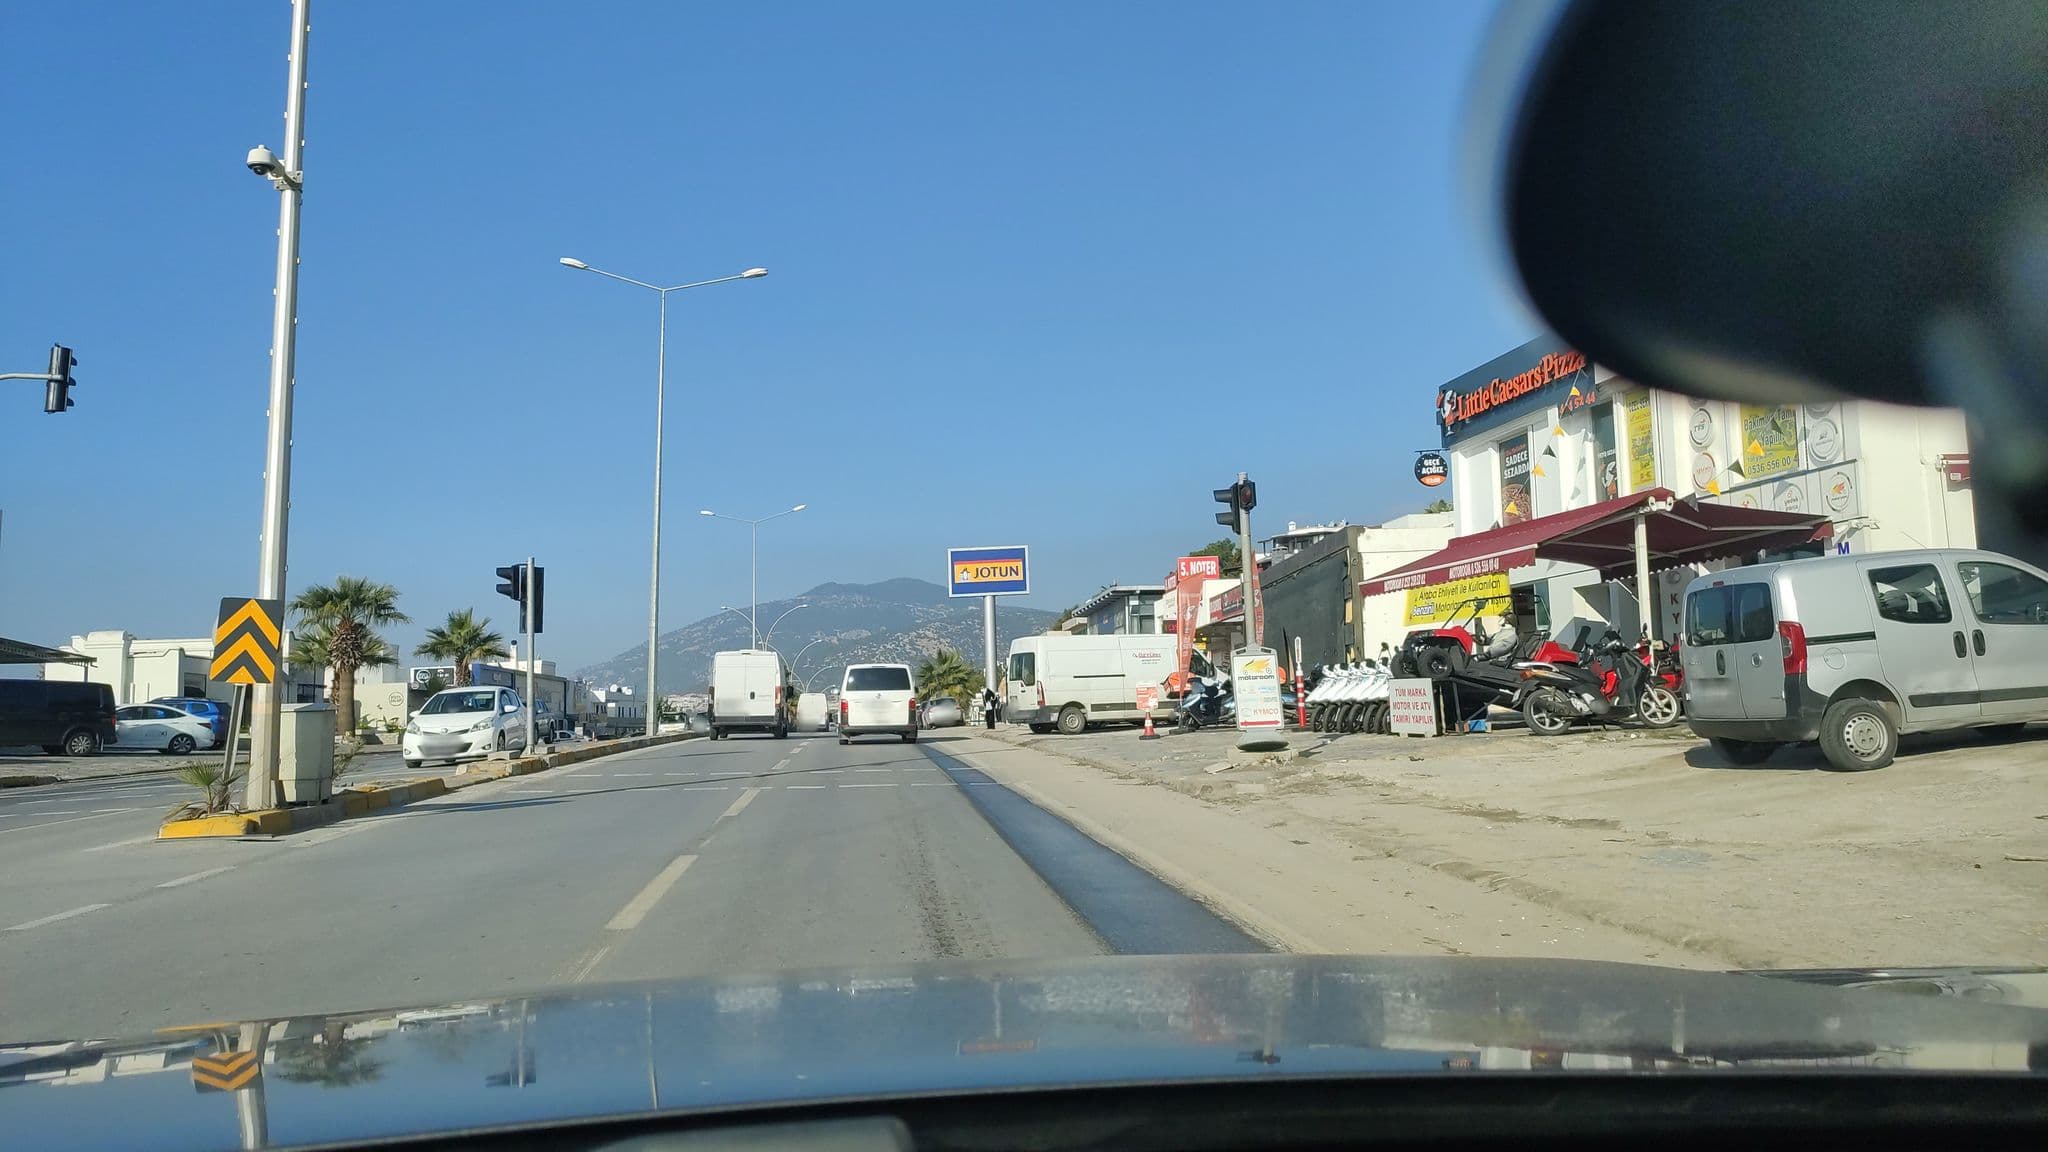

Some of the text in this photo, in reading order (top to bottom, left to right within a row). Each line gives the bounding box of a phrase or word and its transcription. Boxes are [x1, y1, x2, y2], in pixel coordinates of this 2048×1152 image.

[1457, 386, 1490, 420] Little
[1541, 351, 1586, 384] Pizza
[1505, 450, 1528, 467] SADECE
[1837, 541, 1850, 555] M
[973, 565, 1019, 579] JOTUN
[1180, 560, 1217, 577] 5. NOTER
[1408, 687, 1427, 697] MARKA
[1253, 708, 1279, 716] KYMCO
[1392, 701, 1432, 711] MOTOR VE ATV
